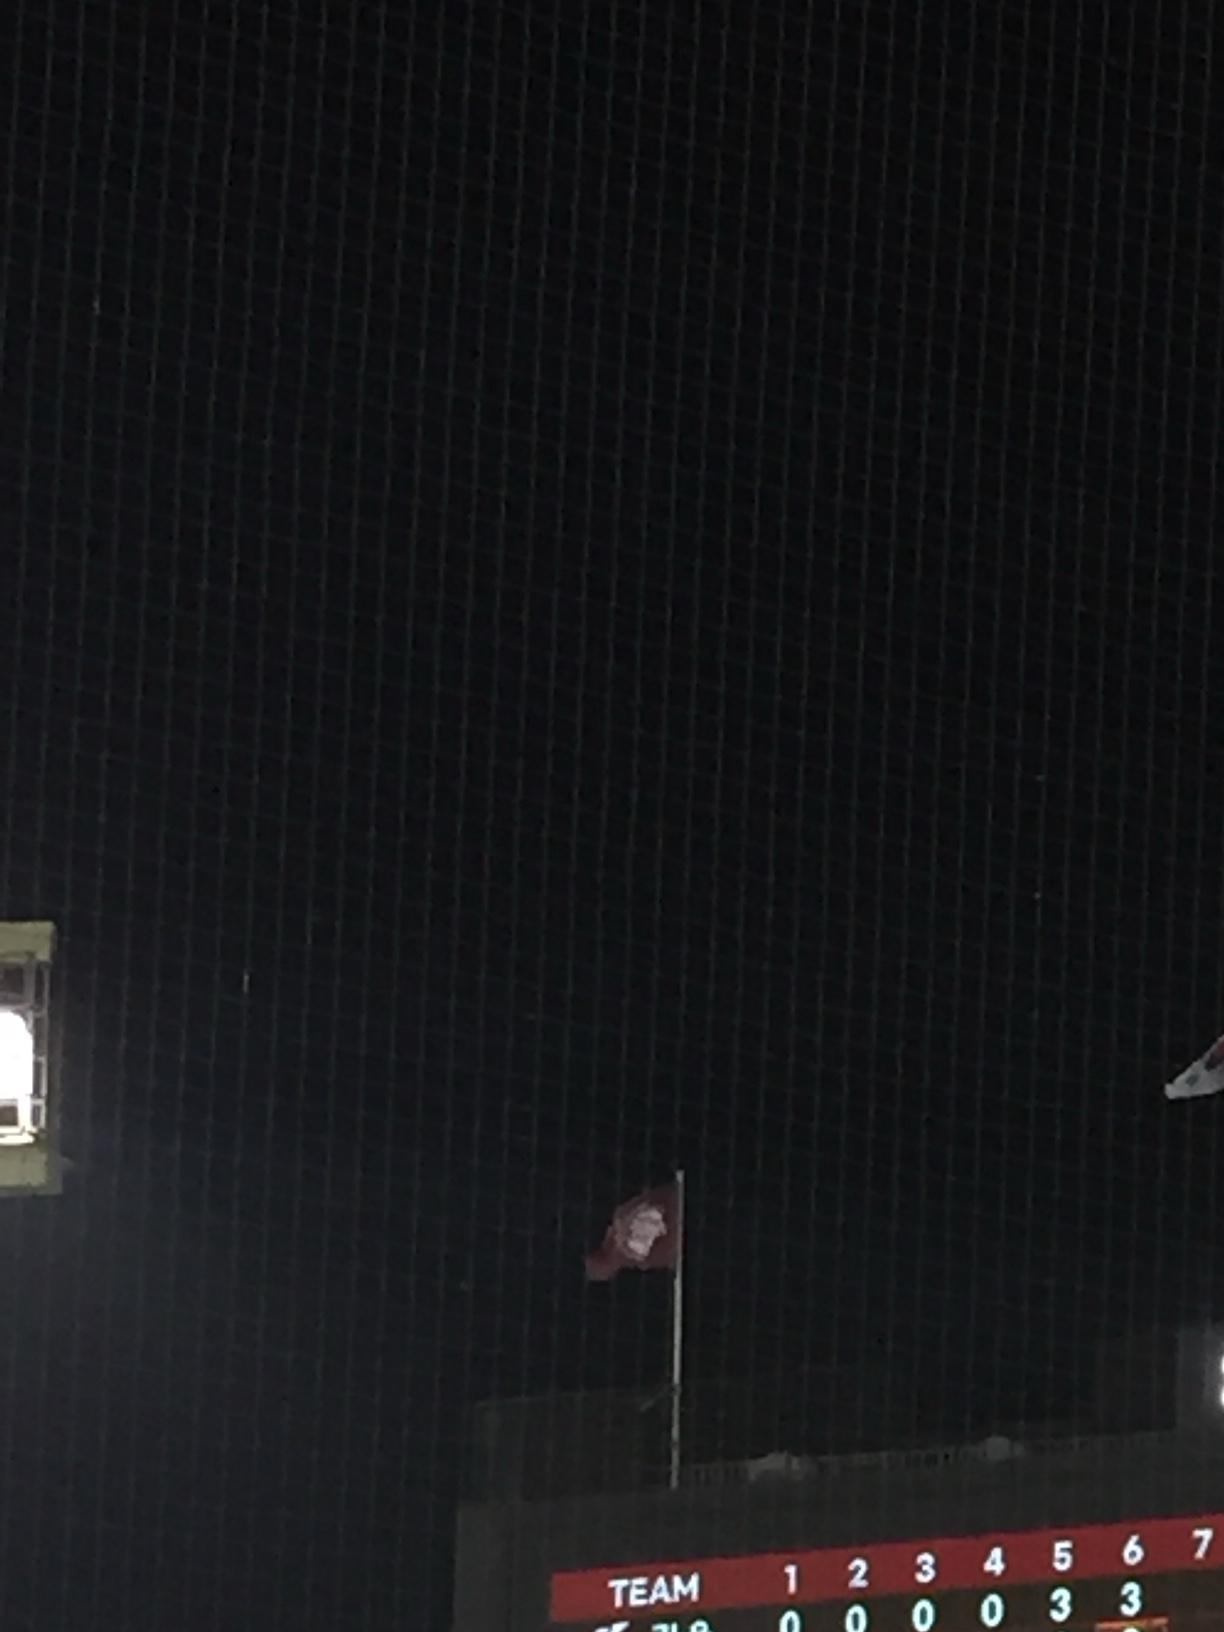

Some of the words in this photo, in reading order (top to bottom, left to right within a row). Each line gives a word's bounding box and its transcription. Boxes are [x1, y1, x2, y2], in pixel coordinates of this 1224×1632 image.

[607, 1572, 700, 1608] TEAM
[784, 1564, 797, 1594] 1
[848, 1557, 869, 1588] 2
[915, 1552, 936, 1584] 3
[983, 1546, 1005, 1576] 4
[1052, 1540, 1073, 1572] 5
[1122, 1534, 1144, 1566] 6
[1192, 1528, 1213, 1559] 7
[980, 1593, 1004, 1628] 0
[1049, 1587, 1072, 1623] 3
[1120, 1581, 1142, 1617] 3
